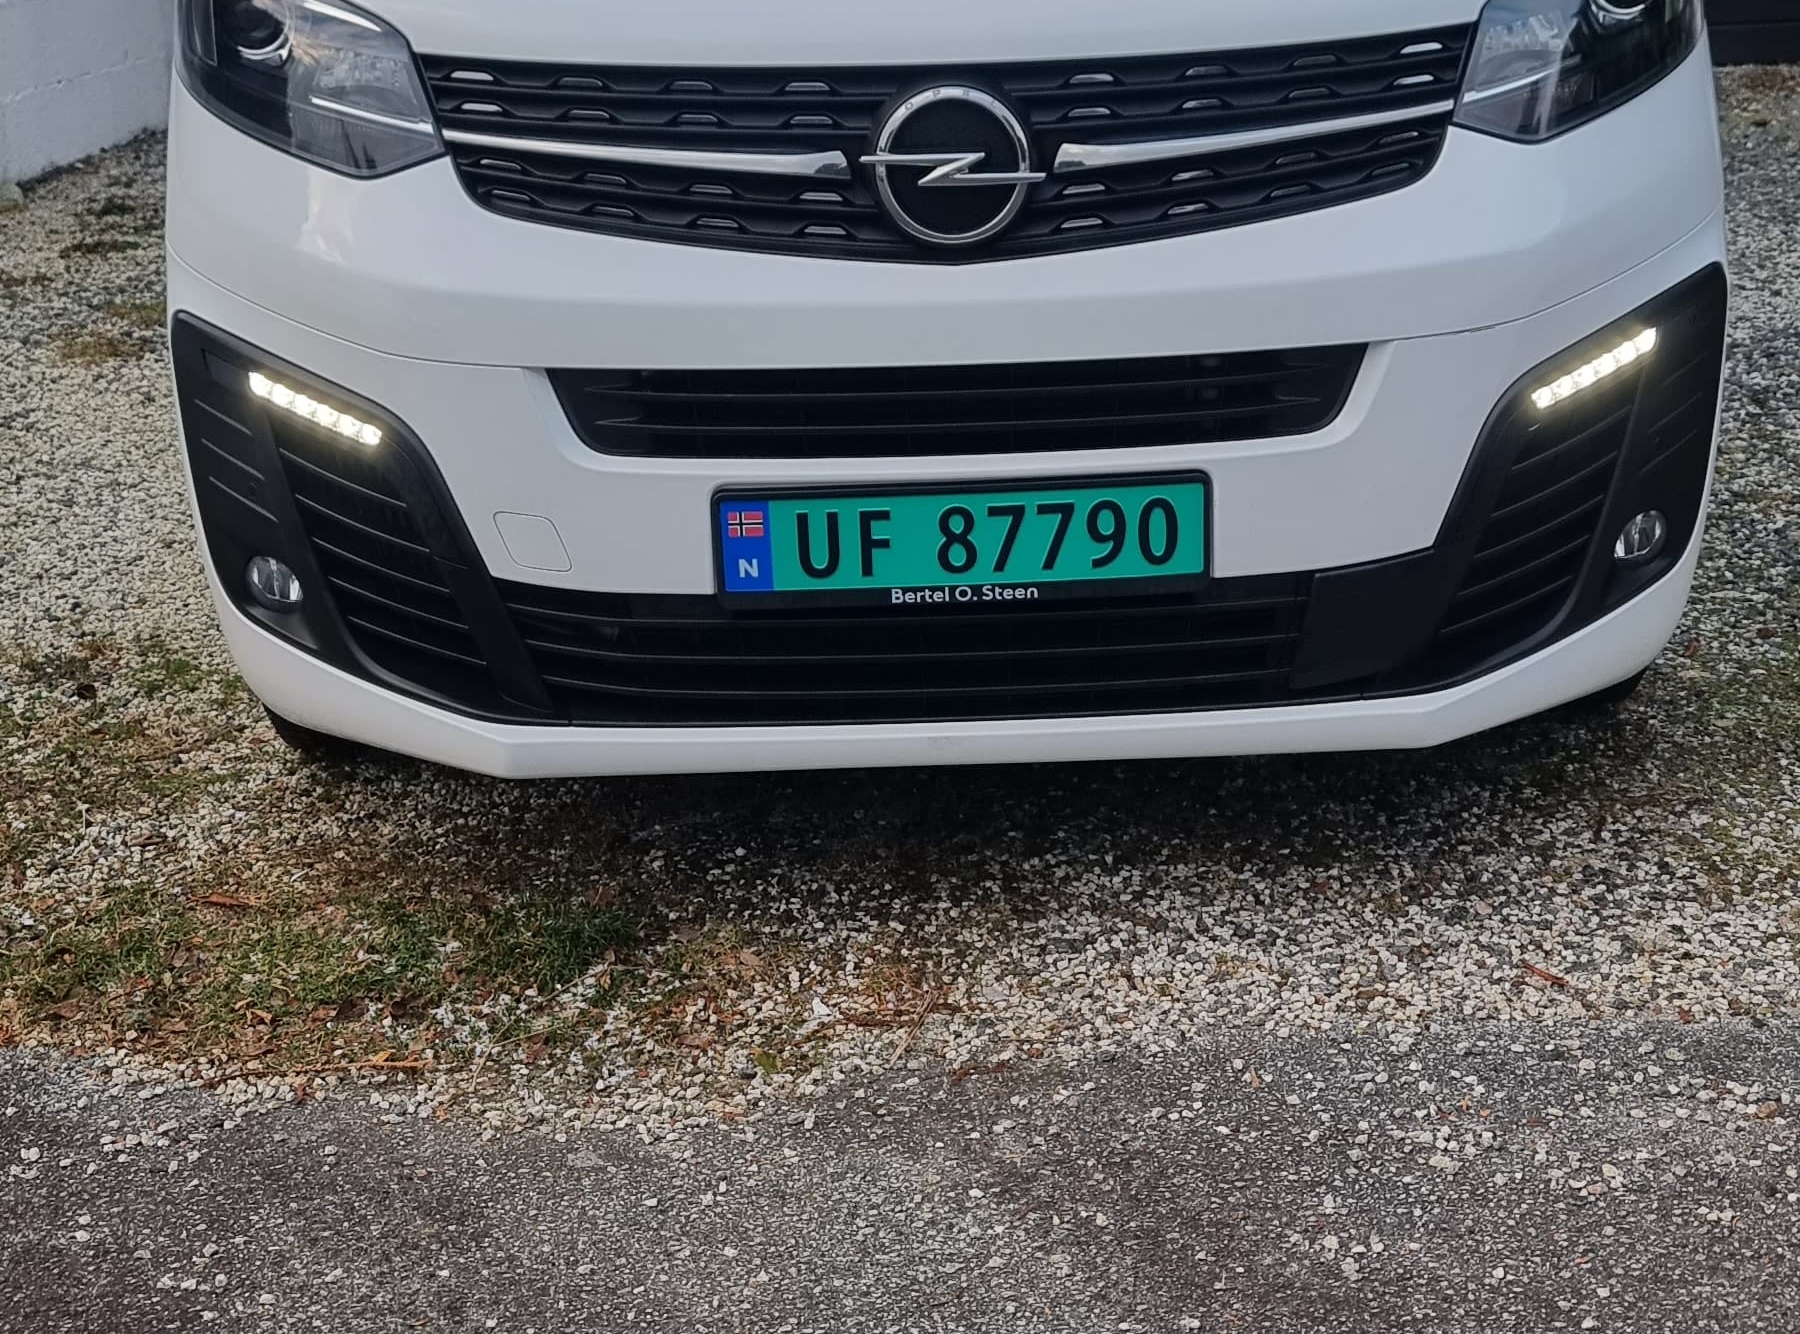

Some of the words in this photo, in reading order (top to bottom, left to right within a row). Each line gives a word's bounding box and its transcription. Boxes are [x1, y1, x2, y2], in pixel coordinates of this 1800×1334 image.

[796, 508, 891, 579] UF
[936, 495, 1179, 574] 87790
[738, 558, 759, 578] N
[891, 586, 950, 604] Bertel
[955, 586, 978, 601] O.
[982, 585, 1038, 600] Steen
